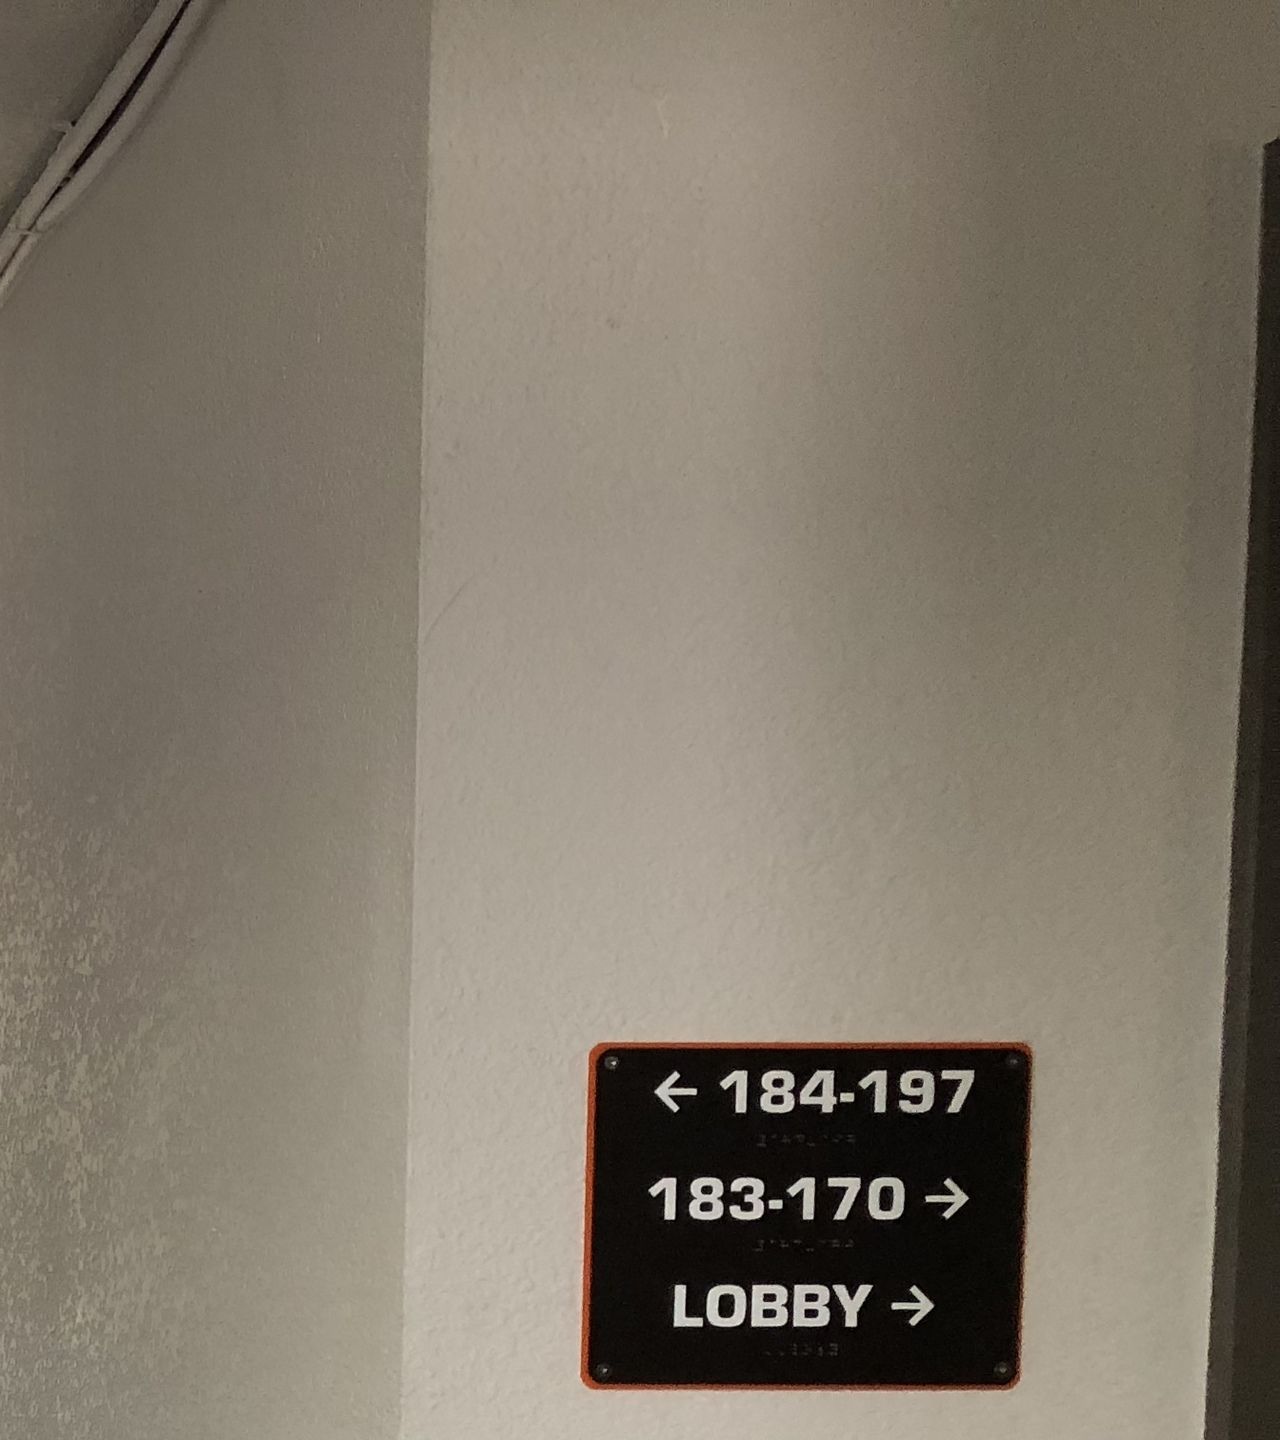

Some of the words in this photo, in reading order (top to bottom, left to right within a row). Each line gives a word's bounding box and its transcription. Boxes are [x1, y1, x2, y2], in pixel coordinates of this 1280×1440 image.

[719, 1069, 975, 1114] 184-197
[648, 1176, 905, 1221] 183-170
[673, 1284, 874, 1328] LOBBY
